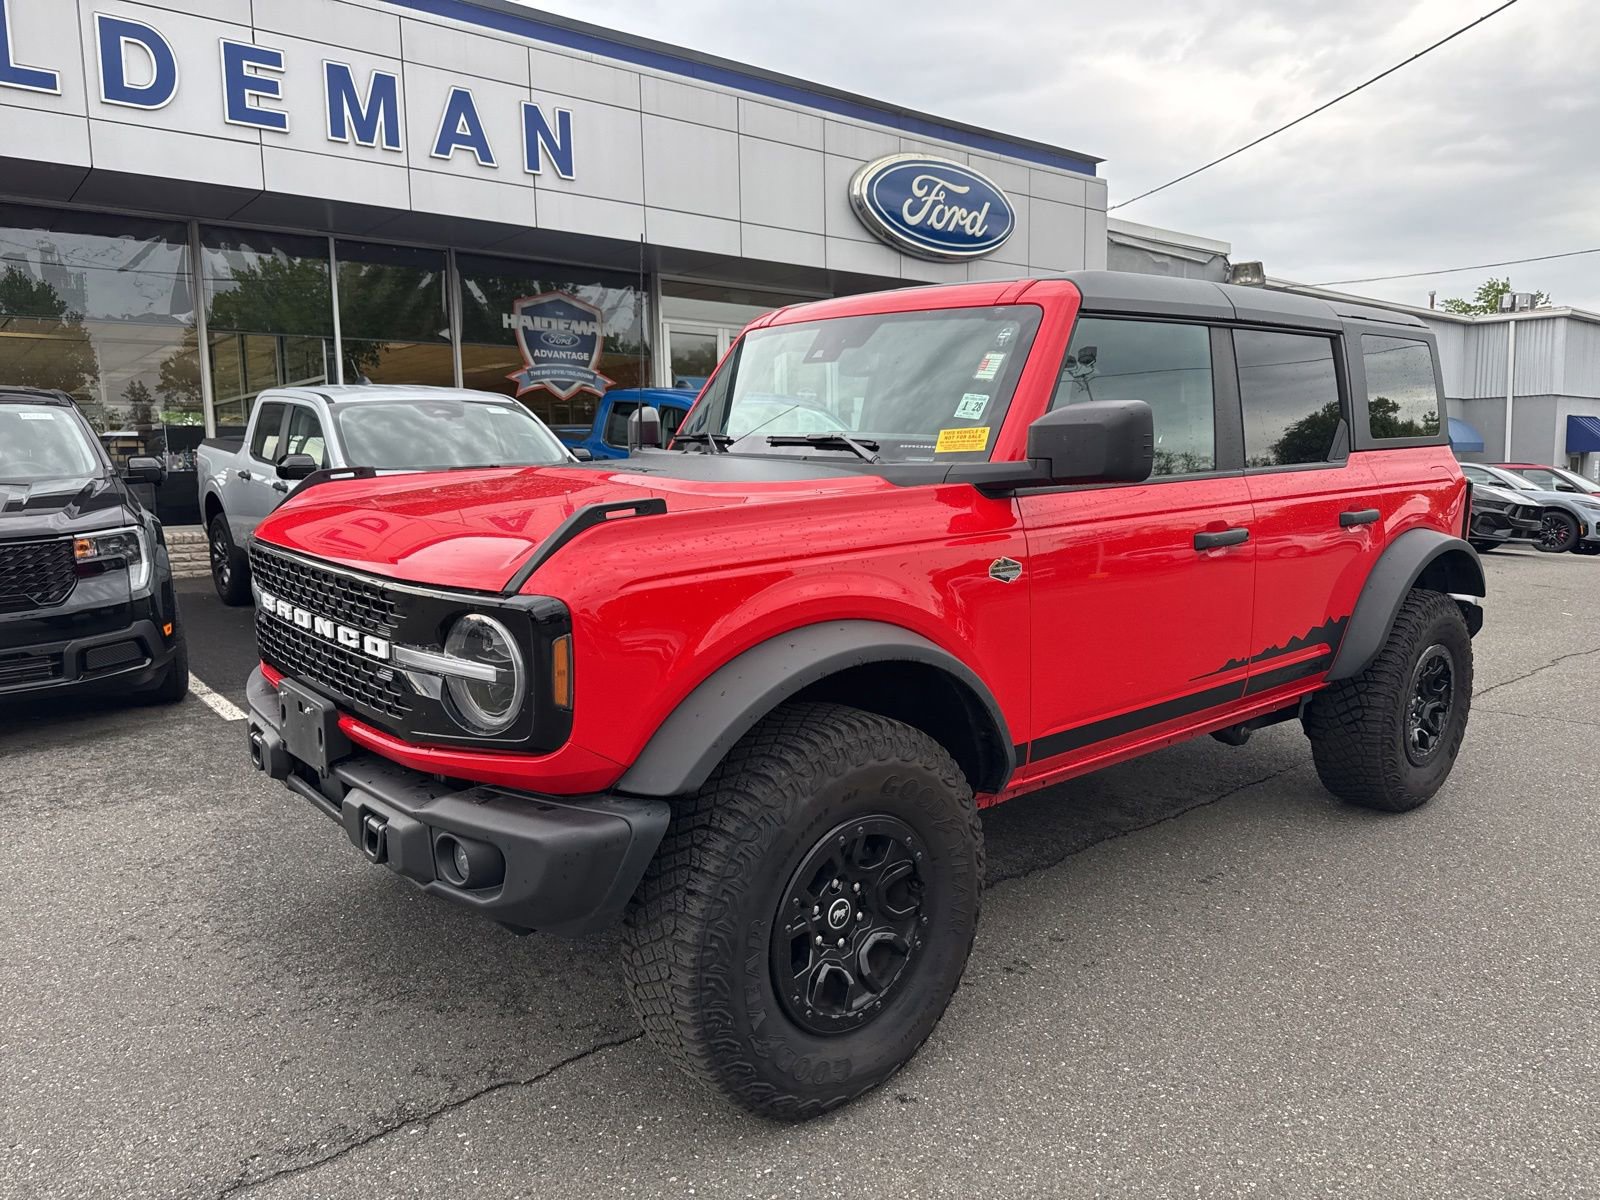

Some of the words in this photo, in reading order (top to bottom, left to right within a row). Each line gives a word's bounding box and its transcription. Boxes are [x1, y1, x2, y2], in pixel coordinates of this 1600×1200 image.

[902, 174, 991, 237] Ford
[548, 333, 573, 346] Ford
[533, 348, 590, 361] ADVANTAGE
[971, 402, 983, 412] 28
[260, 592, 390, 660] BRONCO
